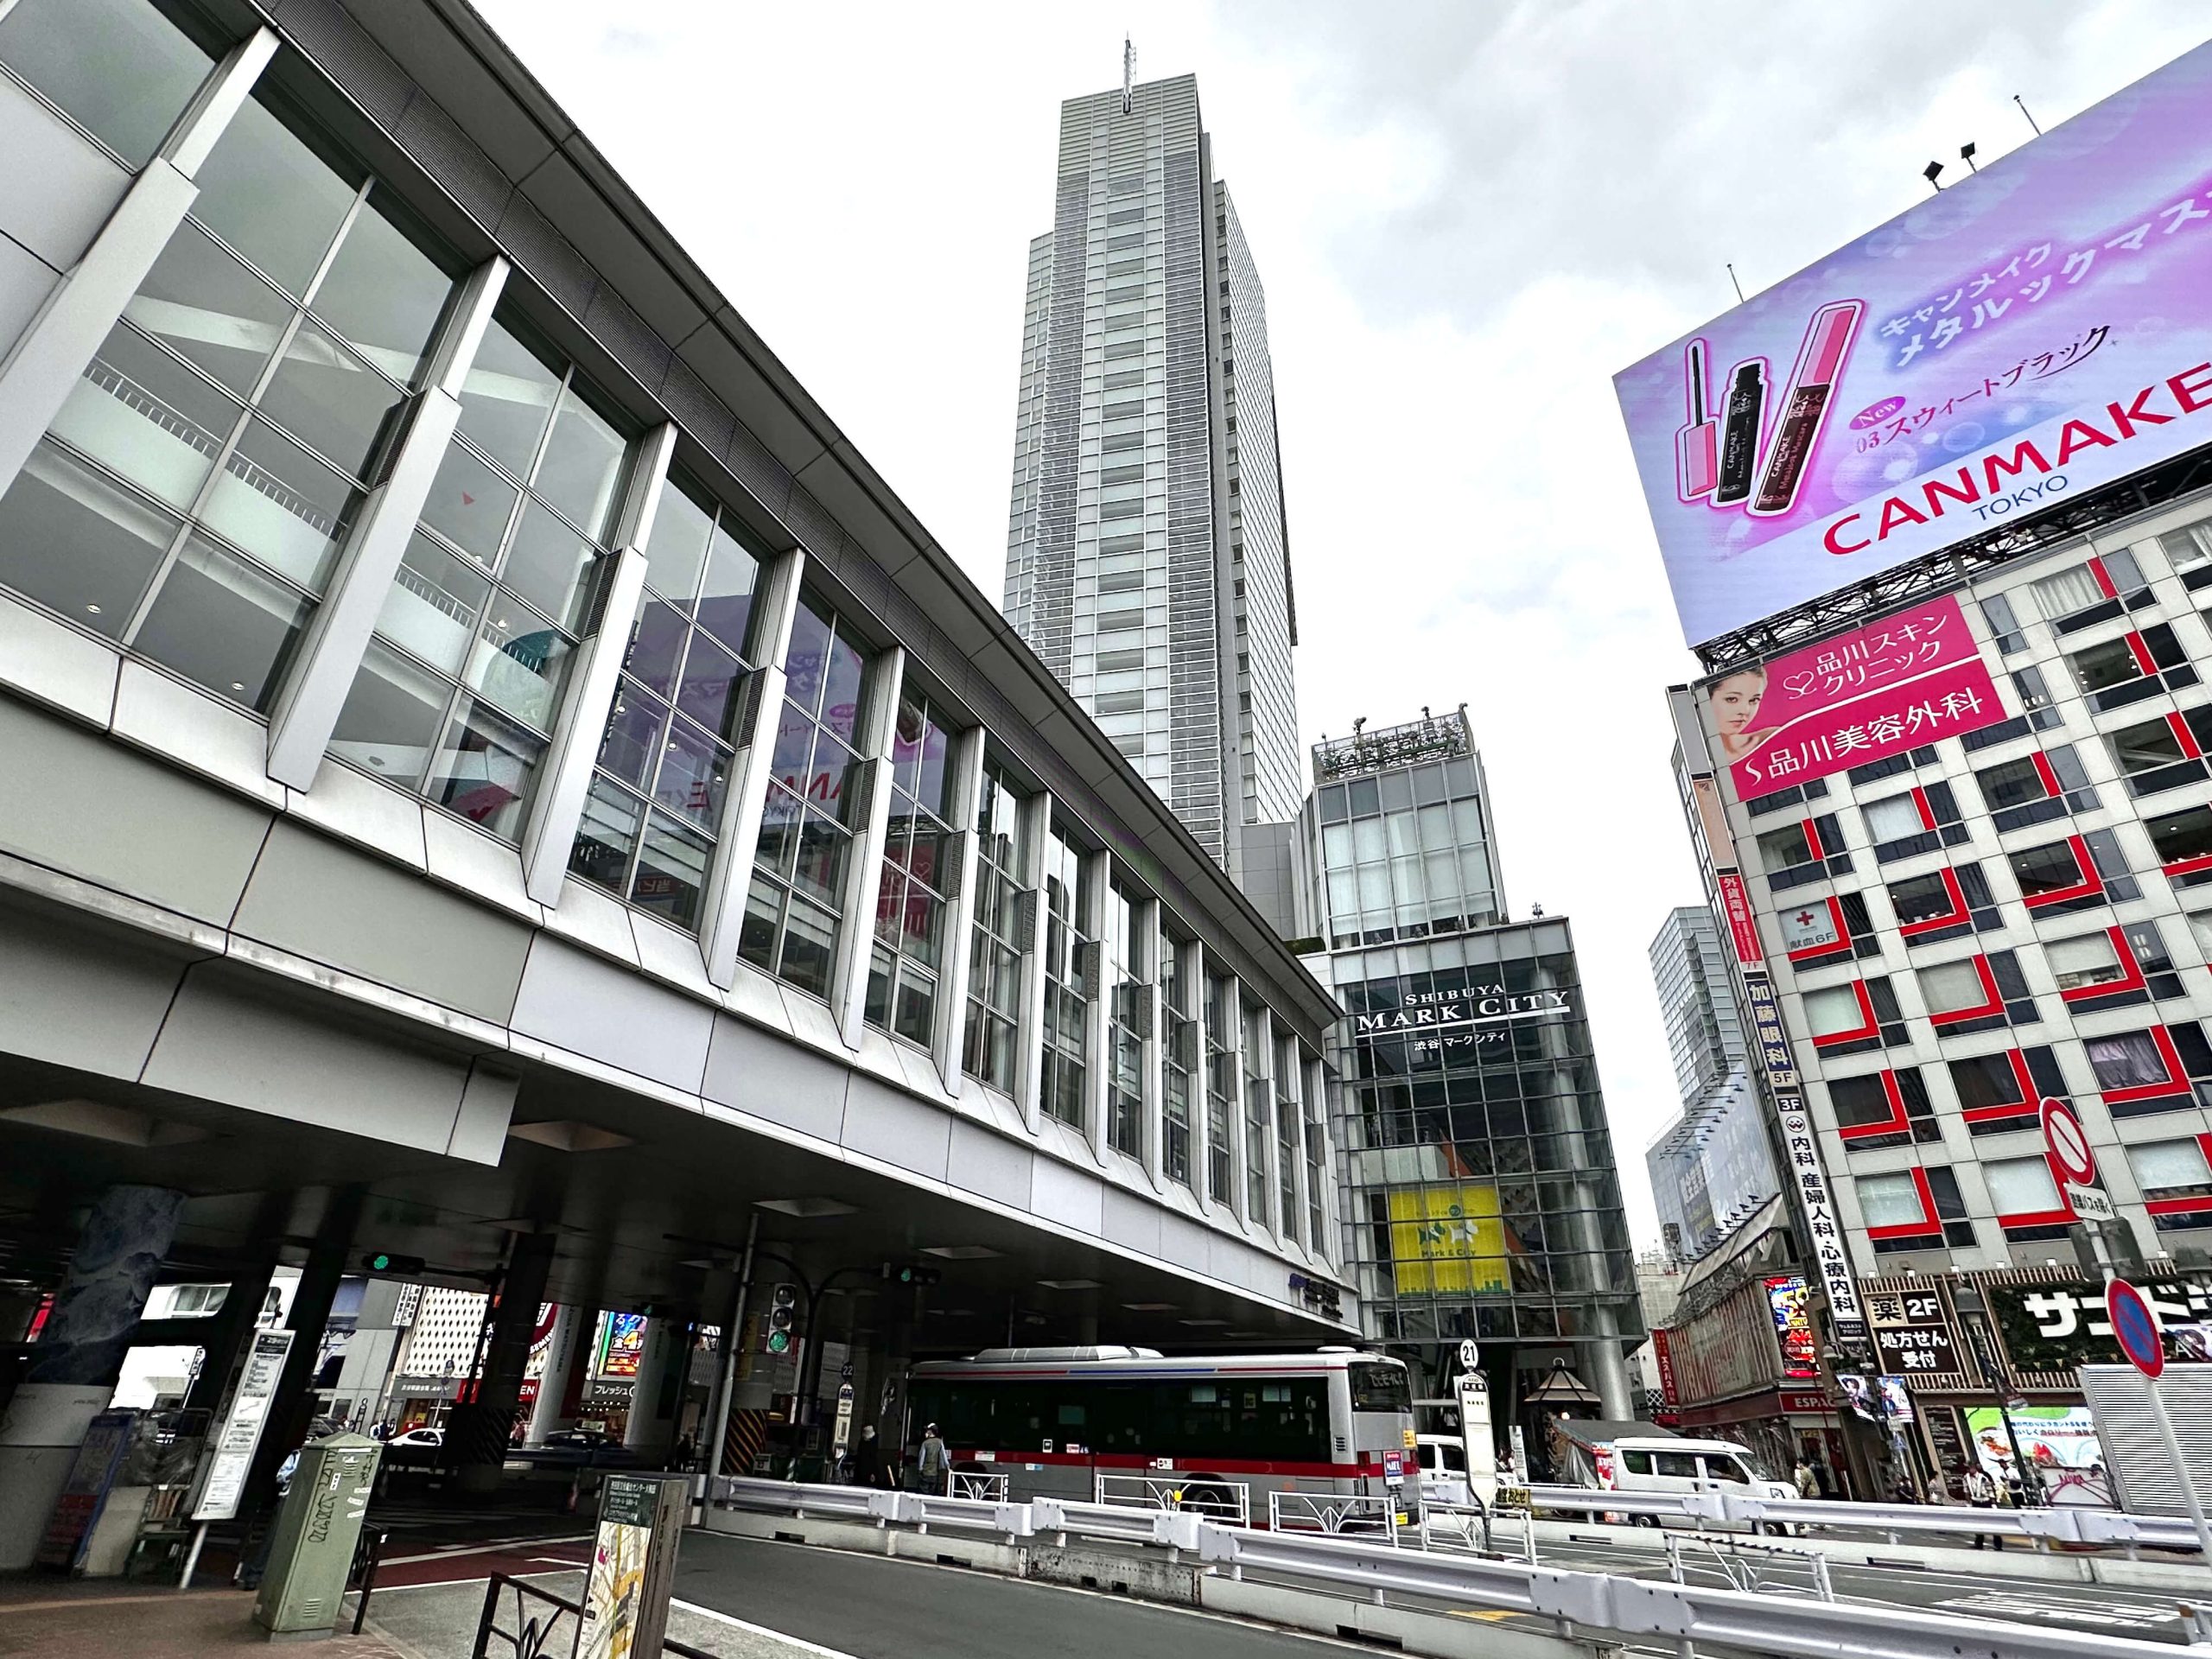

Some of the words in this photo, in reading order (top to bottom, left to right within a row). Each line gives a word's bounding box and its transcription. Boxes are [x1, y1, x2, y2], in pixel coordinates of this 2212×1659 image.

[1880, 242, 2051, 338] キャンメイク
[1897, 191, 2212, 366] メタルックマス
[1858, 398, 1897, 428] New
[1823, 361, 2212, 555] CANMAKE
[1972, 475, 2068, 521] TOKYO
[1816, 614, 1948, 675] 品川スキン
[1822, 640, 1941, 696] クリニック
[1768, 686, 1982, 779] 品川美容外科
[1789, 931, 1834, 949] 献血6F
[1405, 983, 1505, 1006] SHIBUYA
[1357, 1005, 1462, 1032] MARK
[1478, 991, 1568, 1016] CITY
[1749, 984, 1789, 1066] 加藤眼科
[1414, 1039, 1440, 1052] 渋谷
[1444, 1033, 1506, 1047] マークシティ
[1774, 1072, 1792, 1084] 5F
[1779, 1099, 1800, 1111] 3F
[1792, 1136, 1815, 1166] 内科
[1872, 1297, 1901, 1321] 薬
[1906, 1298, 1938, 1318] 2F
[1463, 1345, 1476, 1362] 21
[1880, 1331, 1948, 1349] 処方せん
[842, 1365, 854, 1376] 22
[1902, 1350, 1936, 1370] 受付
